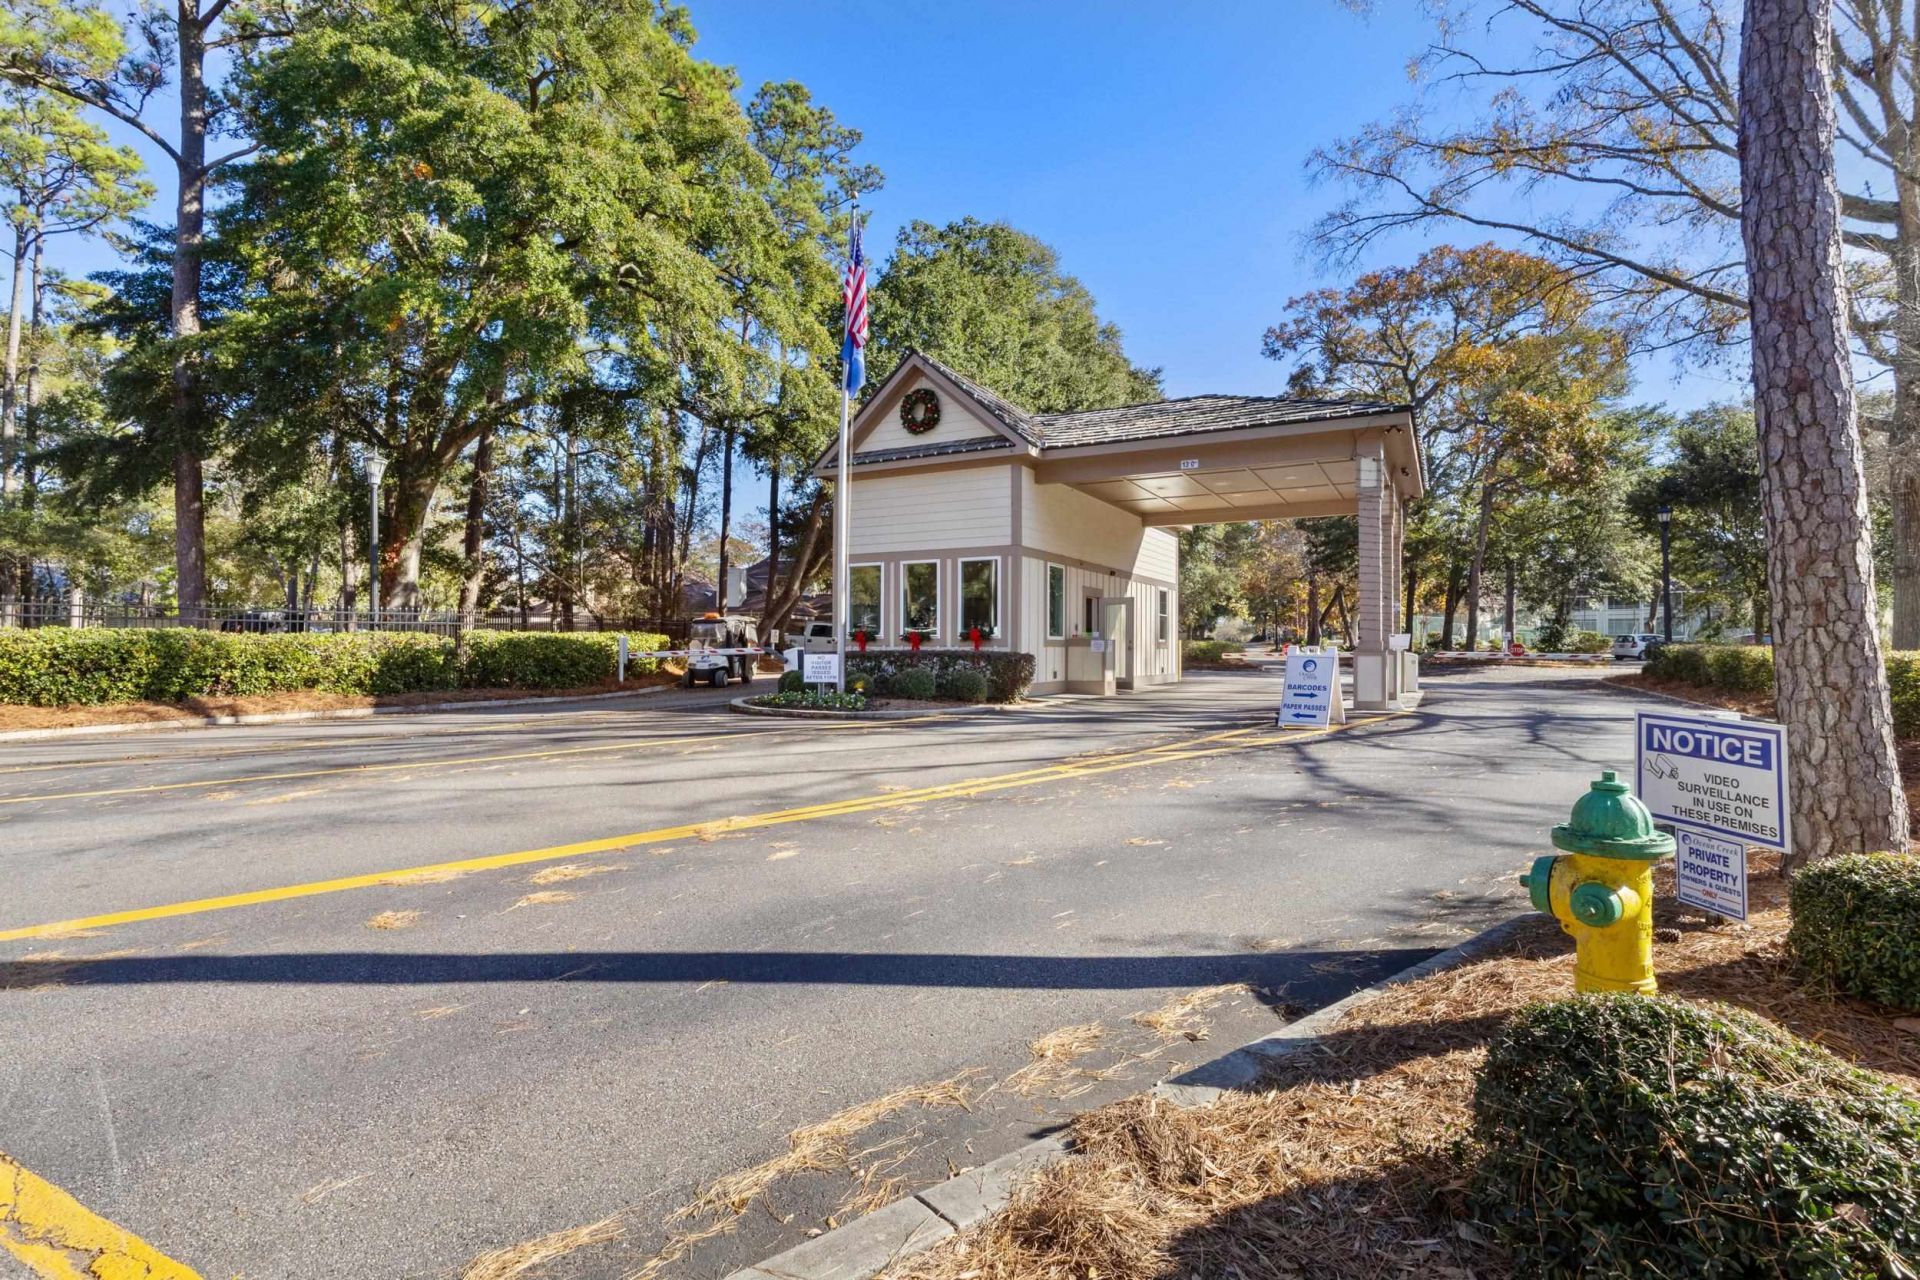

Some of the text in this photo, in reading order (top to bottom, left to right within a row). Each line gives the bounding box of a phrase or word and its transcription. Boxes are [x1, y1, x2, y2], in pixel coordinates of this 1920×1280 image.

[1652, 727, 1764, 766] NOTICE
[1703, 773, 1740, 789] VIDEO
[1677, 781, 1770, 809] SURVEILLANCE
[1693, 797, 1753, 819] IN USE ON
[1672, 804, 1778, 838] THESE PREMISES
[1688, 846, 1730, 868] PRIVATE
[1692, 838, 1739, 856] Ocean Creek
[1682, 860, 1738, 887] PROPERTY
[1680, 873, 1707, 887] OWNERS
[1714, 884, 1742, 898] GUESTS
[1701, 888, 1718, 899] ONLY
